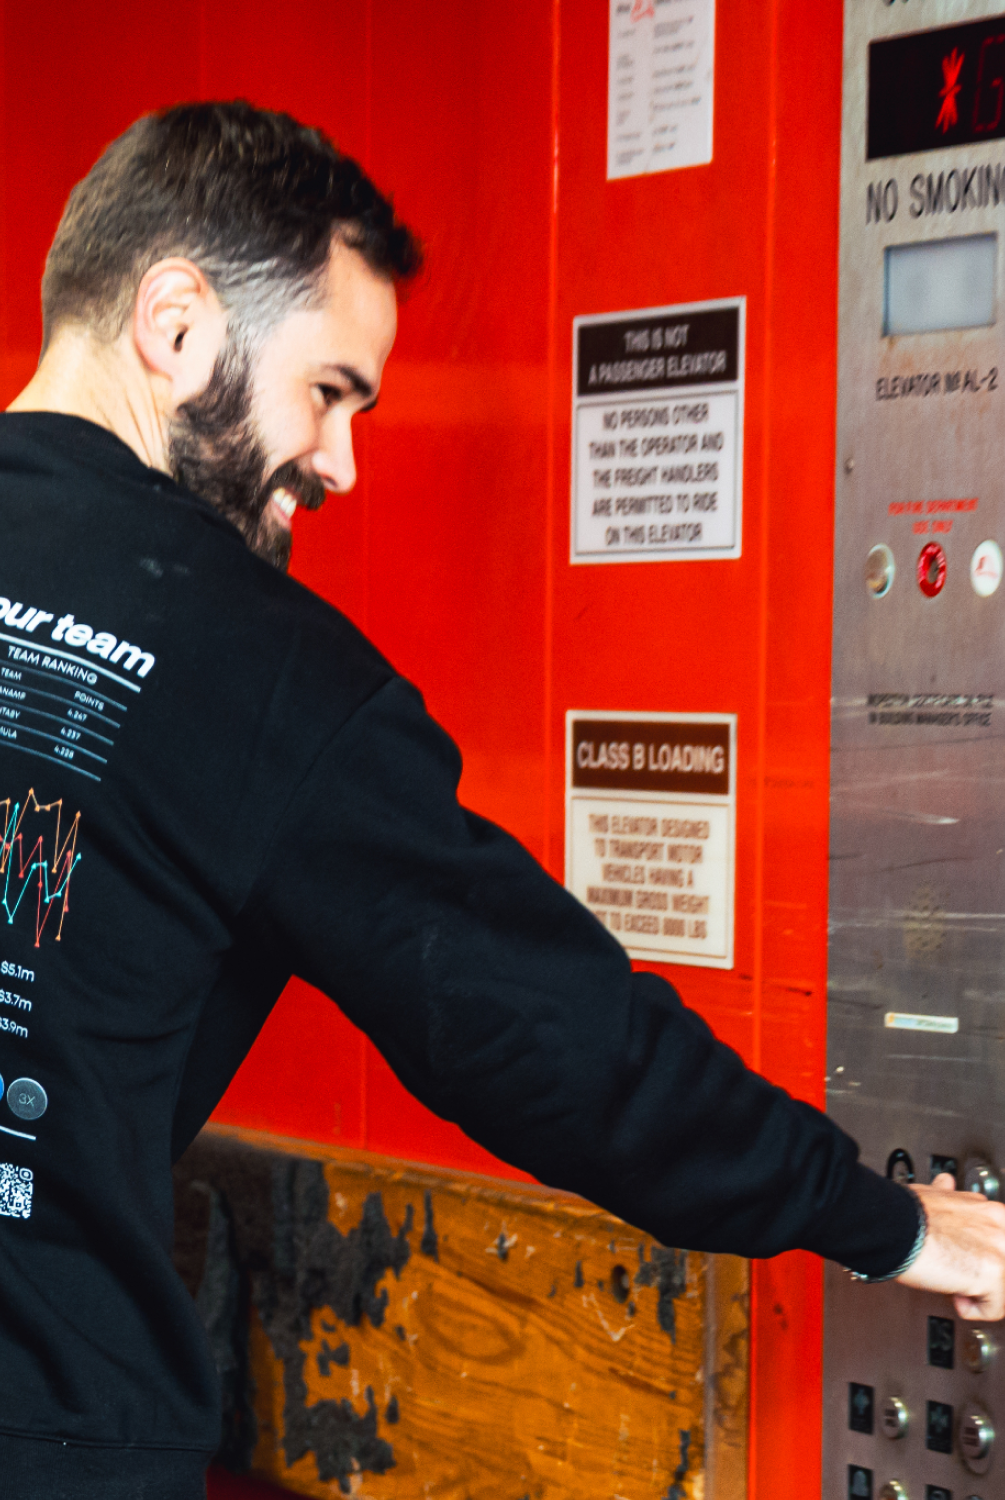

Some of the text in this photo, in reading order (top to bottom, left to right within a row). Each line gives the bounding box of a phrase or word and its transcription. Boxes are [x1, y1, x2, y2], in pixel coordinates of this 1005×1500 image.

[867, 163, 1005, 226] NO SMOKIN
[624, 324, 690, 353] THIS IS NOT
[588, 350, 727, 386] A PASSENGER ELEVATOR
[875, 371, 941, 401] ELEVATOR
[603, 402, 709, 430] NO PERSONS OTHER
[589, 430, 724, 459] THAN THE OPERATOR AND
[593, 461, 719, 489] THE FREIGHT HANDLERS
[592, 491, 718, 517] ARE PERMITTED TO RIDE
[606, 522, 702, 546] ON THIS ELEVATOR
[51, 613, 155, 678] team
[7, 645, 98, 686] TEAM RANKING
[1, 666, 22, 681] TEAM
[74, 690, 105, 712] POINTS
[576, 740, 725, 774] CLASS B LOADING
[588, 813, 710, 840] THIS ELEVATOR DESIGNED
[594, 837, 703, 864] TO TRANSPORT MOTOR
[602, 863, 645, 885] VEHICLES
[648, 867, 684, 888] HAVING
[671, 893, 710, 915] WEIGHT
[609, 911, 622, 931] TO
[624, 913, 660, 935] EXCEED
[0, 959, 35, 983] $5.1m
